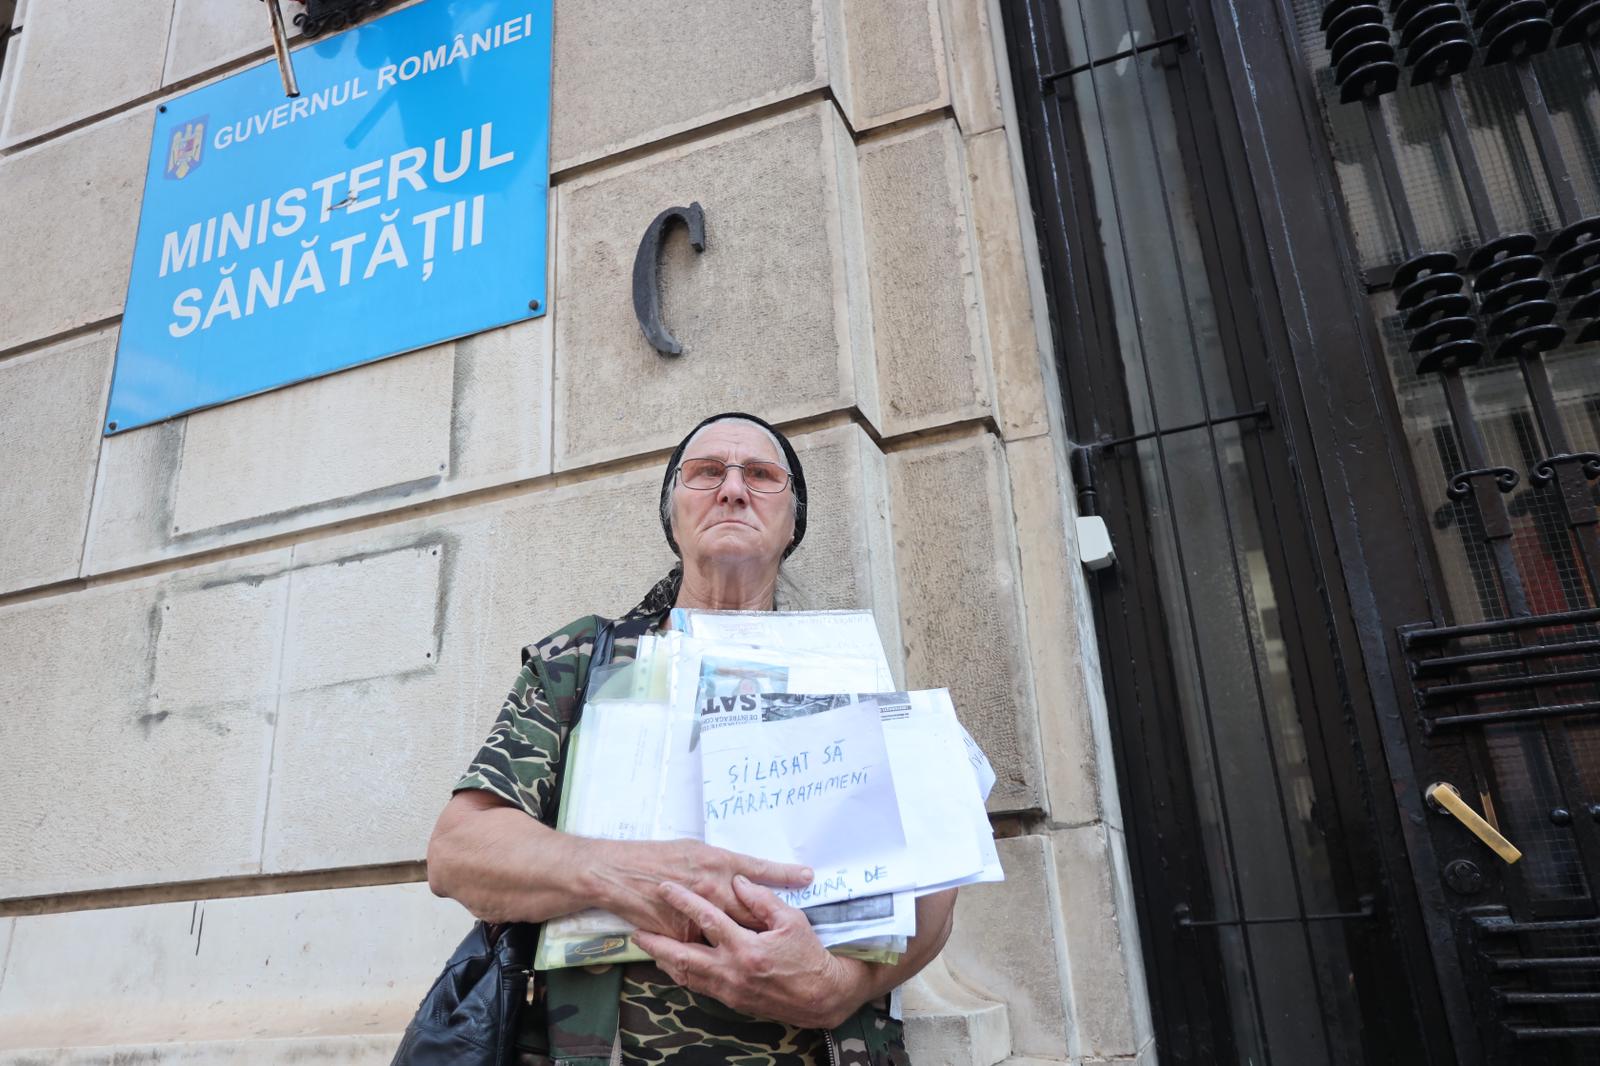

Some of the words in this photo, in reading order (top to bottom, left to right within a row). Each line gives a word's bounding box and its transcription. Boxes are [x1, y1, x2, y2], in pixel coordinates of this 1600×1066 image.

[213, 76, 369, 150] GUVERNUL
[377, 14, 533, 91] ROMÂNIEI
[158, 122, 515, 278] MINISTERUL
[864, 864, 888, 883] DE
